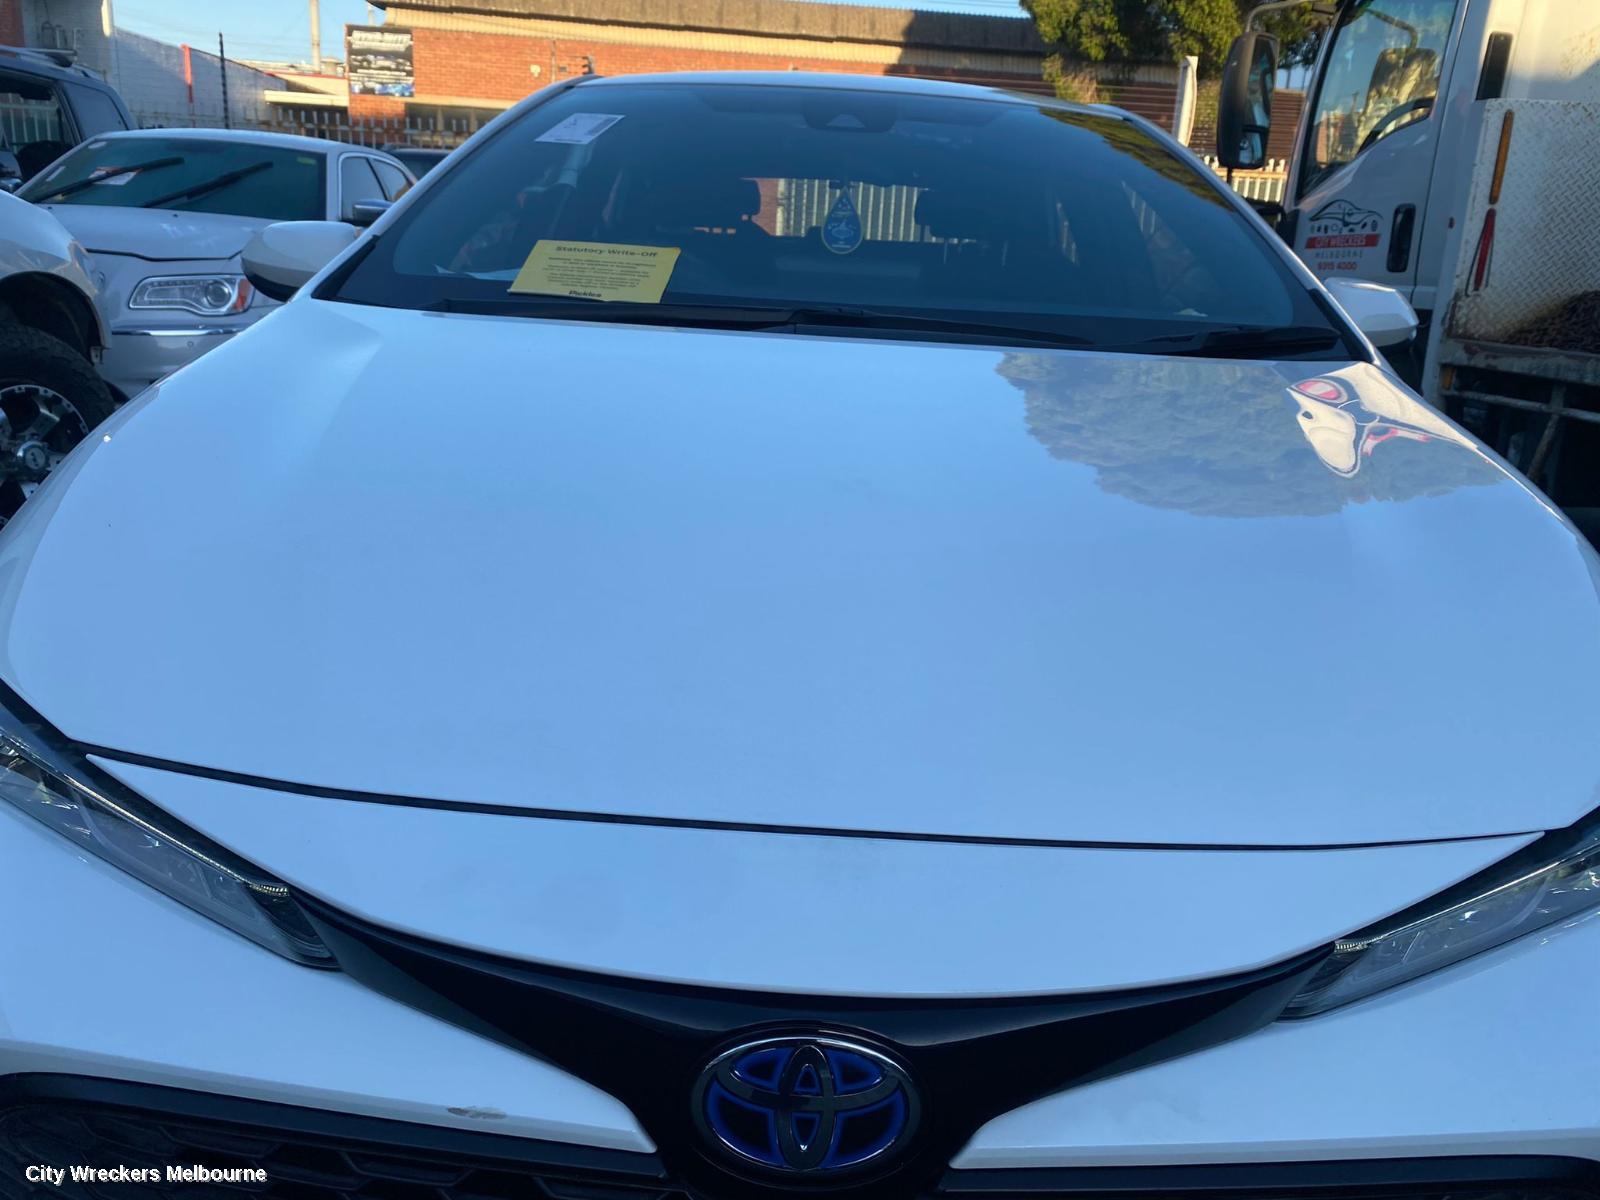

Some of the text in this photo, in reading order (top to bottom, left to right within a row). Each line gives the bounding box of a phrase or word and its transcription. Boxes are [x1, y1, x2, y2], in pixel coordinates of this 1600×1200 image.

[556, 246, 658, 257] Statutory Write-Off
[568, 290, 602, 298] Pickles
